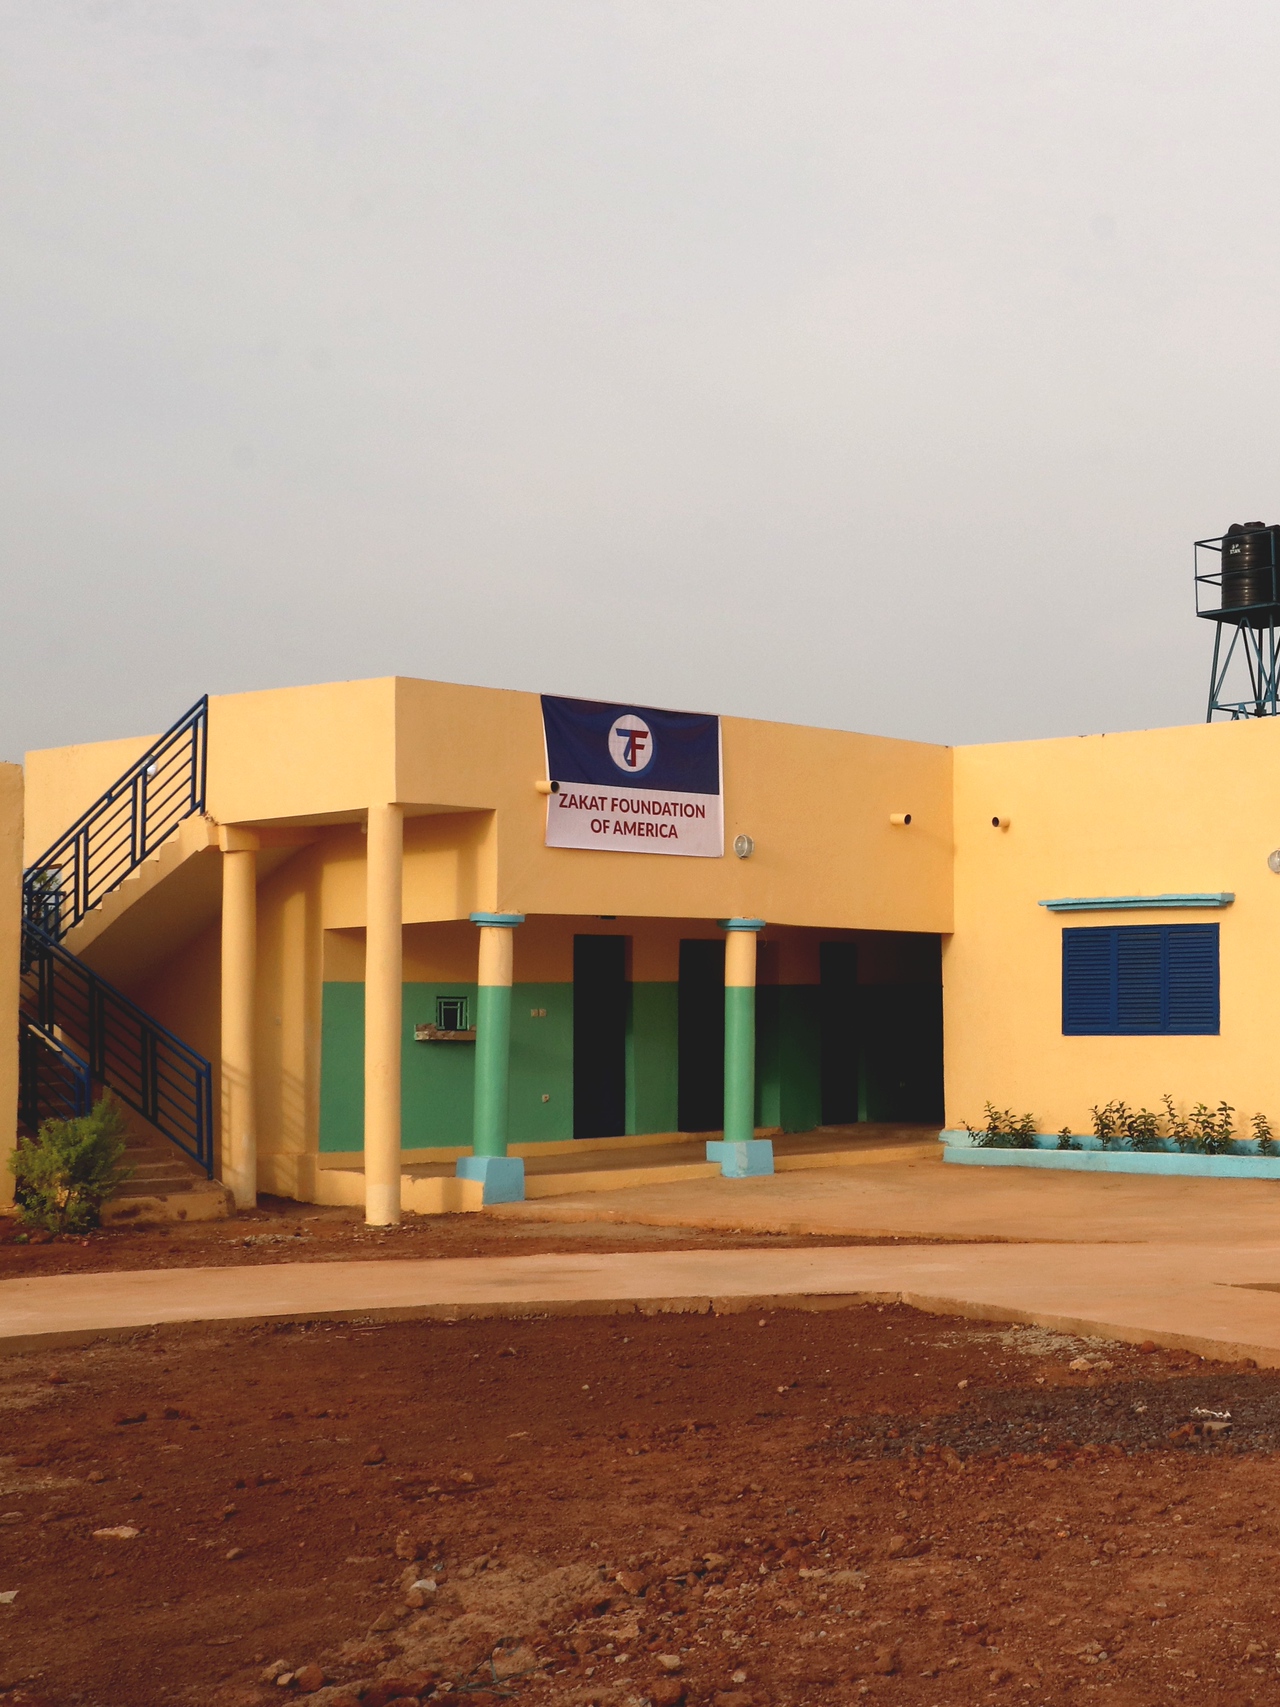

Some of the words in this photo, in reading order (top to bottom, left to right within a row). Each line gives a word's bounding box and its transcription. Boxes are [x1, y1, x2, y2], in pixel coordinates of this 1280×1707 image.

[558, 793, 608, 812] ZAKAT
[610, 797, 706, 819] FOUNDATION
[590, 818, 610, 834] OF
[613, 820, 679, 839] AMERICA
